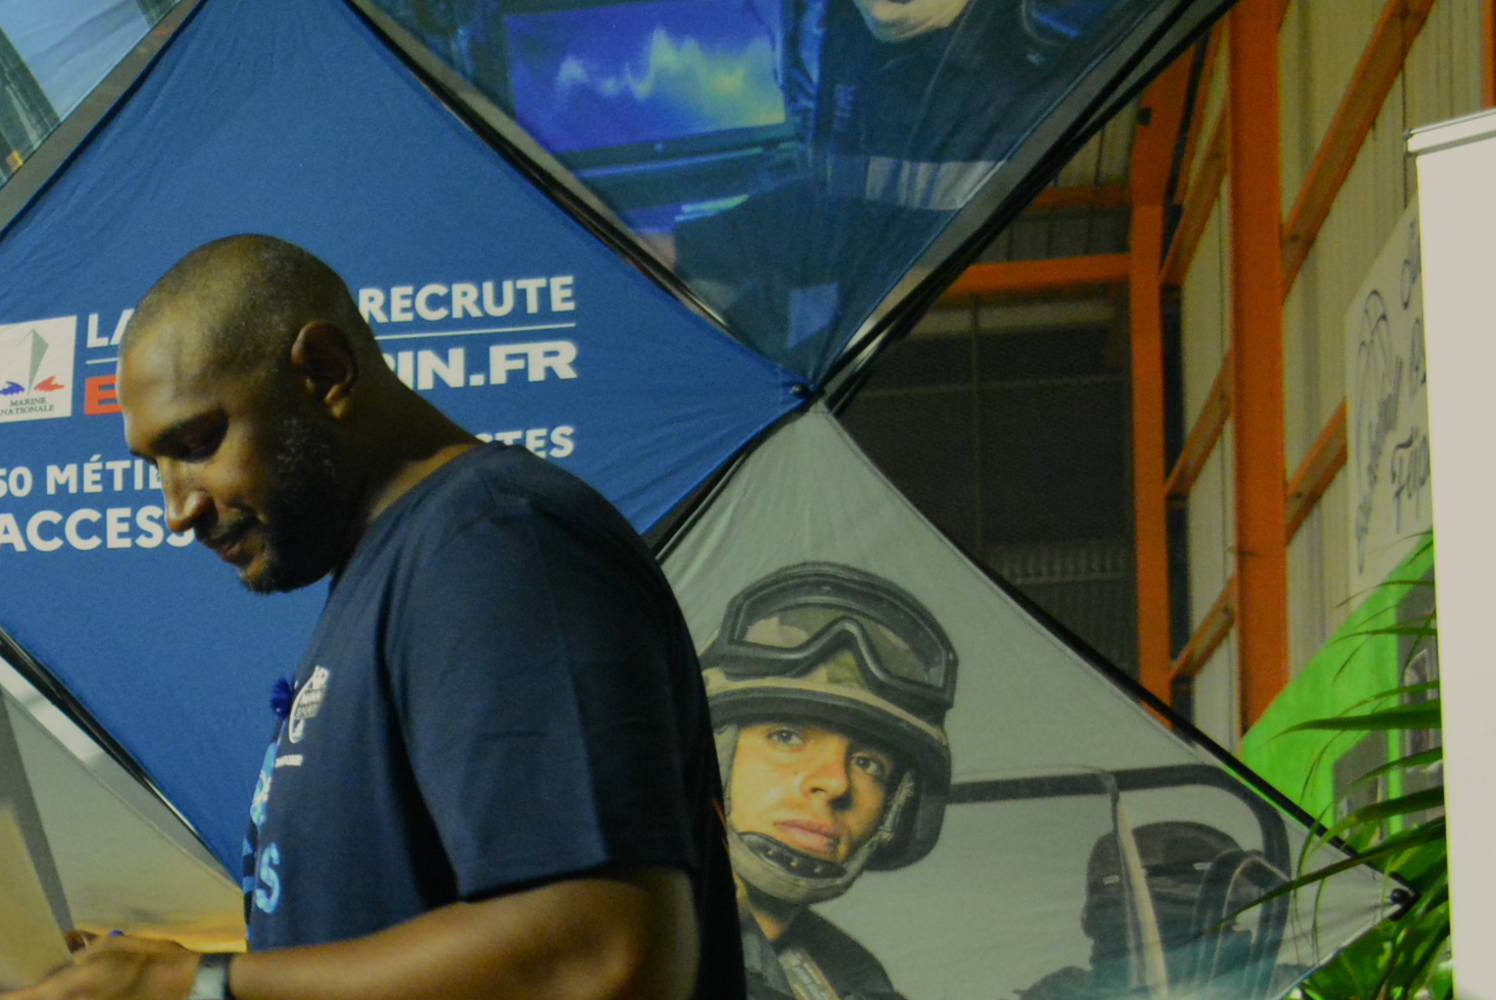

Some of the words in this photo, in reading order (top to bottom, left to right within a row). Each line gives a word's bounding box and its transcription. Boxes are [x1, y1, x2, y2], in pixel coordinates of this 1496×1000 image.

[358, 275, 576, 324] RECRUTE
[0, 404, 55, 416] NATIONALE
[9, 397, 47, 408] MARINE
[46, 453, 163, 495] MÉTIE
